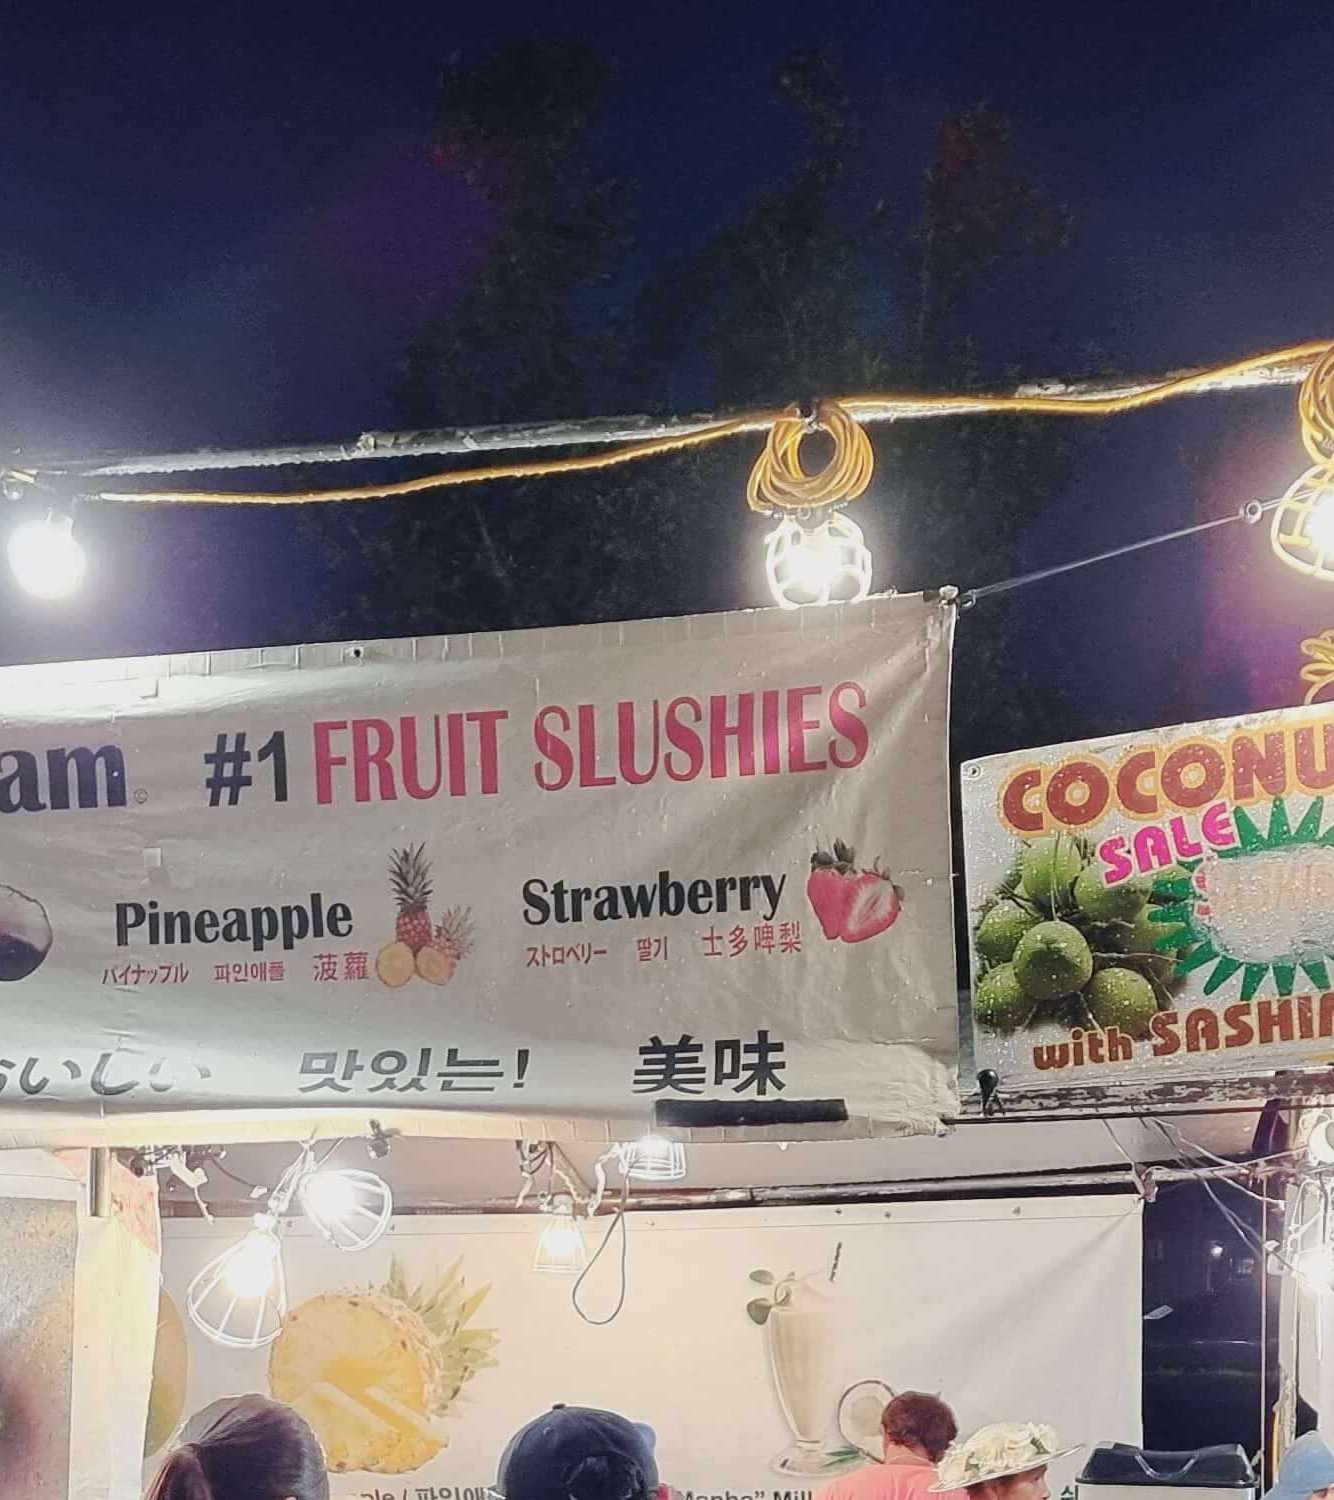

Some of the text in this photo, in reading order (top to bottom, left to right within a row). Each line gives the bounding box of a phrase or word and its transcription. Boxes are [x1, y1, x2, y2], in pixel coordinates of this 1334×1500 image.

[203, 729, 288, 807] #1
[313, 709, 509, 806] FRUIT
[534, 681, 870, 792] SLUSHIES
[1098, 802, 1236, 885] SALE
[522, 870, 786, 926] Strawberry
[115, 893, 353, 952] Pineapple
[702, 920, 803, 958] 士多啤梨
[526, 942, 608, 967] ストロベリー
[637, 936, 668, 962] 딸기
[214, 961, 285, 984] 파인애플
[298, 1047, 530, 1093] 맛있는!
[631, 1029, 787, 1096] 美味
[1033, 1027, 1133, 1071] with
